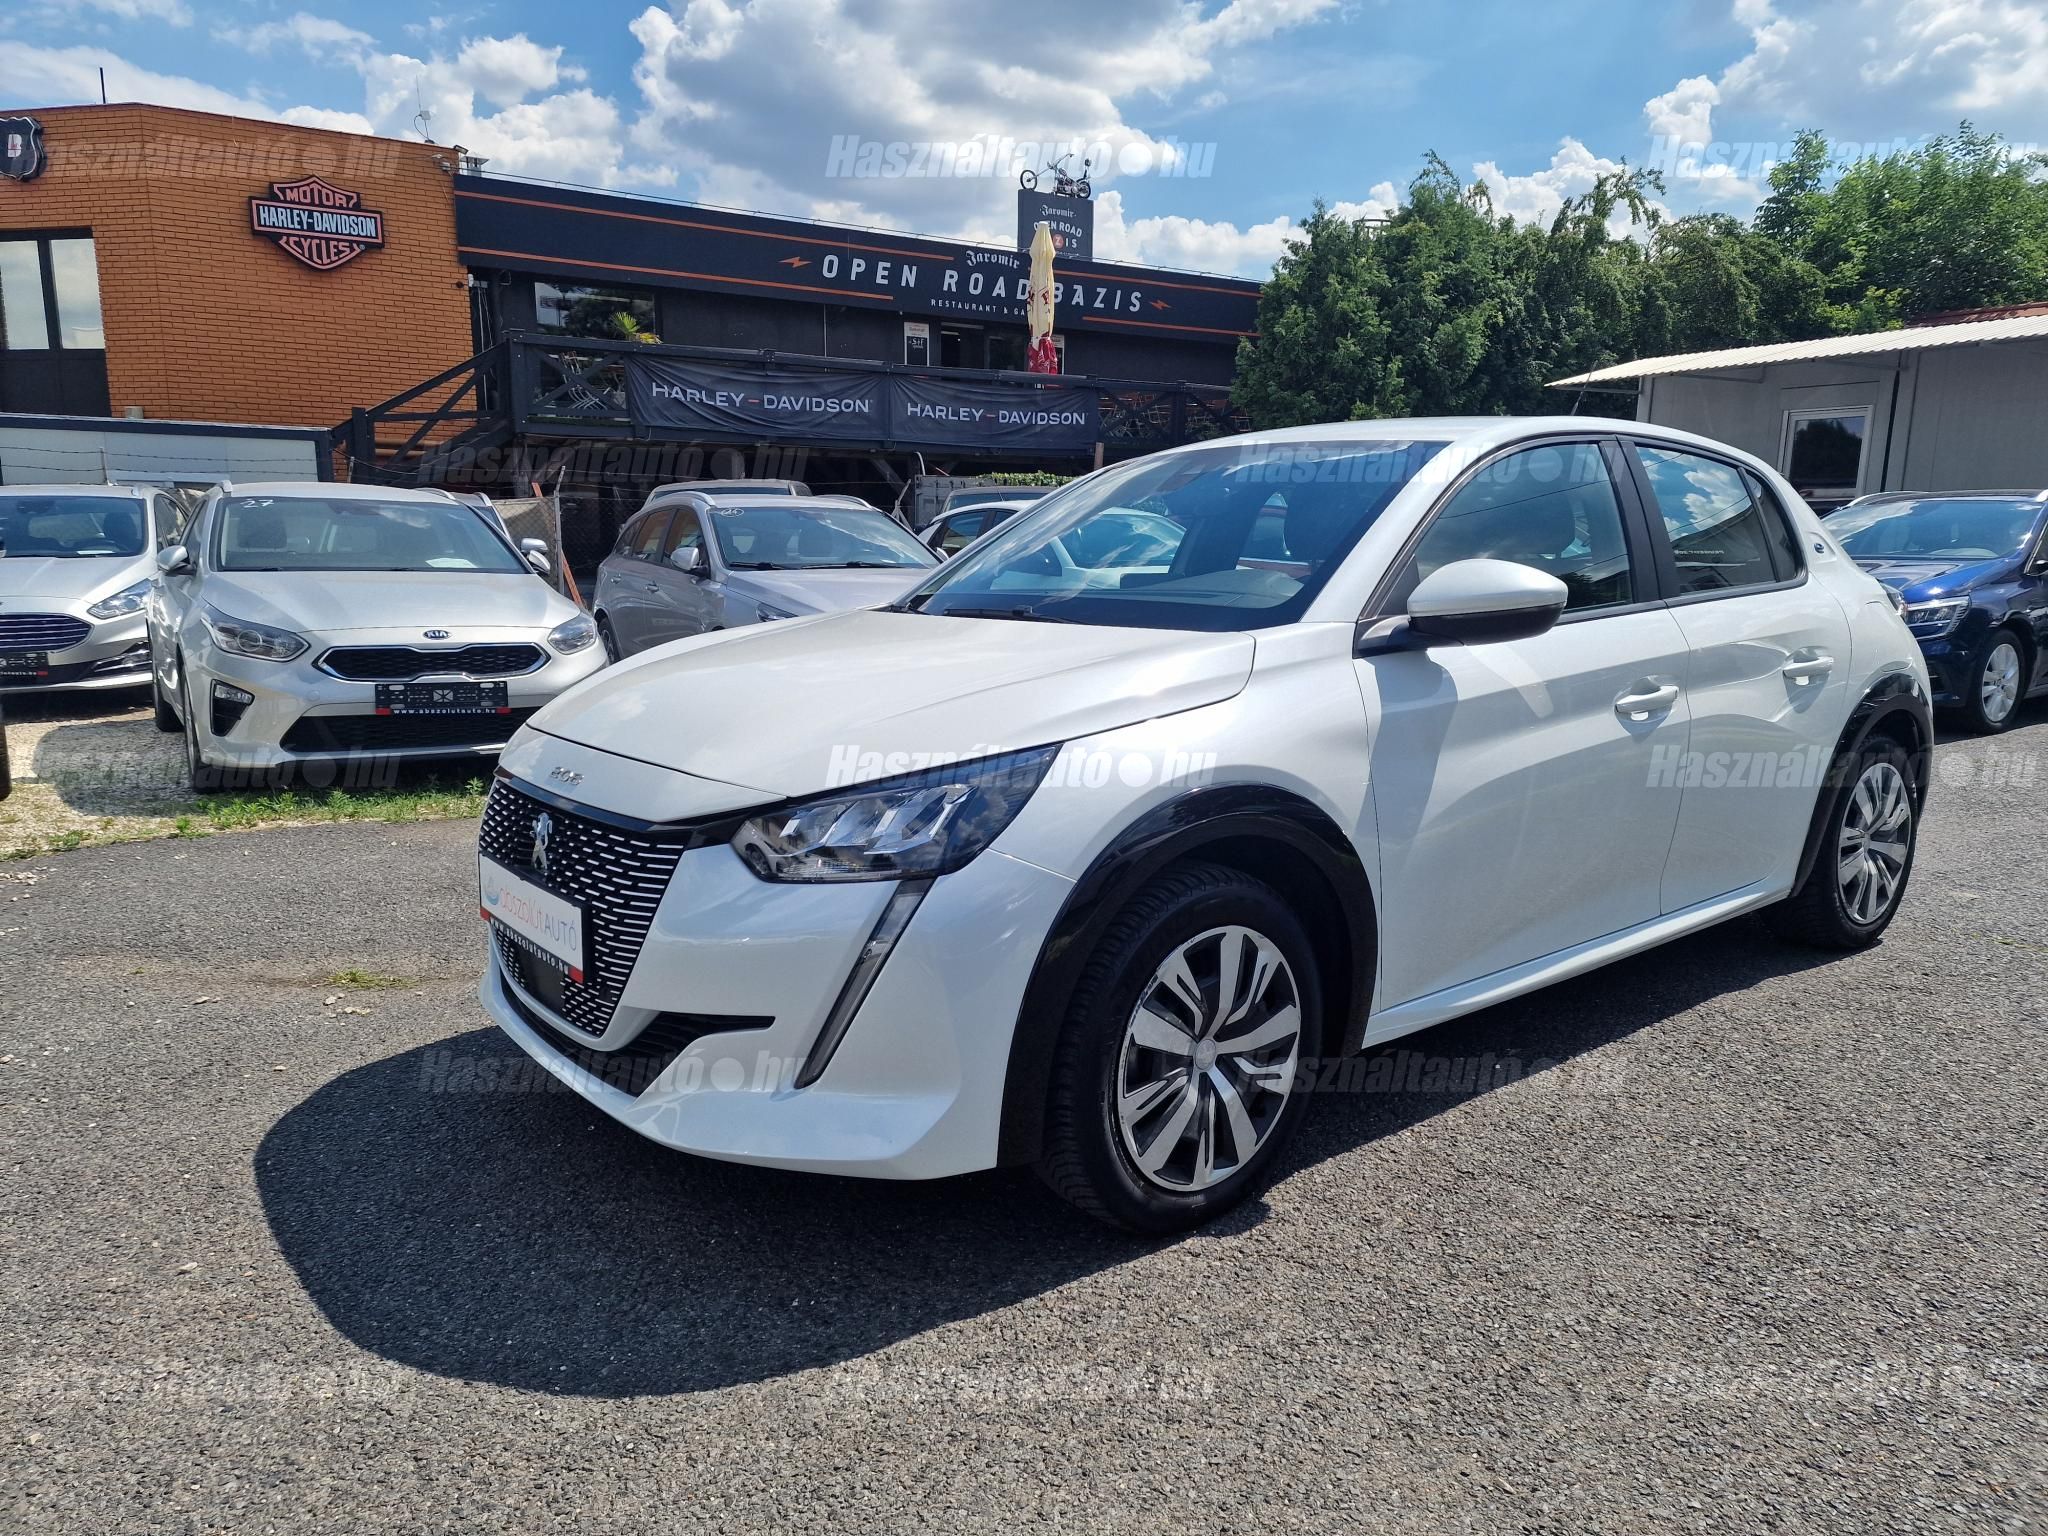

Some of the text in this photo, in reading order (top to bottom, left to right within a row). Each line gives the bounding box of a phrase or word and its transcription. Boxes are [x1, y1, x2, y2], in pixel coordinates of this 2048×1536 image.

[285, 183, 348, 208] MOTOR
[260, 205, 376, 237] HARLEY-DAVIDSON
[1059, 221, 1083, 237] ROAD
[289, 237, 351, 264] CYCLES
[966, 250, 1021, 270] Jaromir
[822, 254, 917, 288] OPEN
[942, 269, 1030, 301] ROAD
[930, 298, 997, 314] RESTAURANT
[426, 630, 448, 638] KIA
